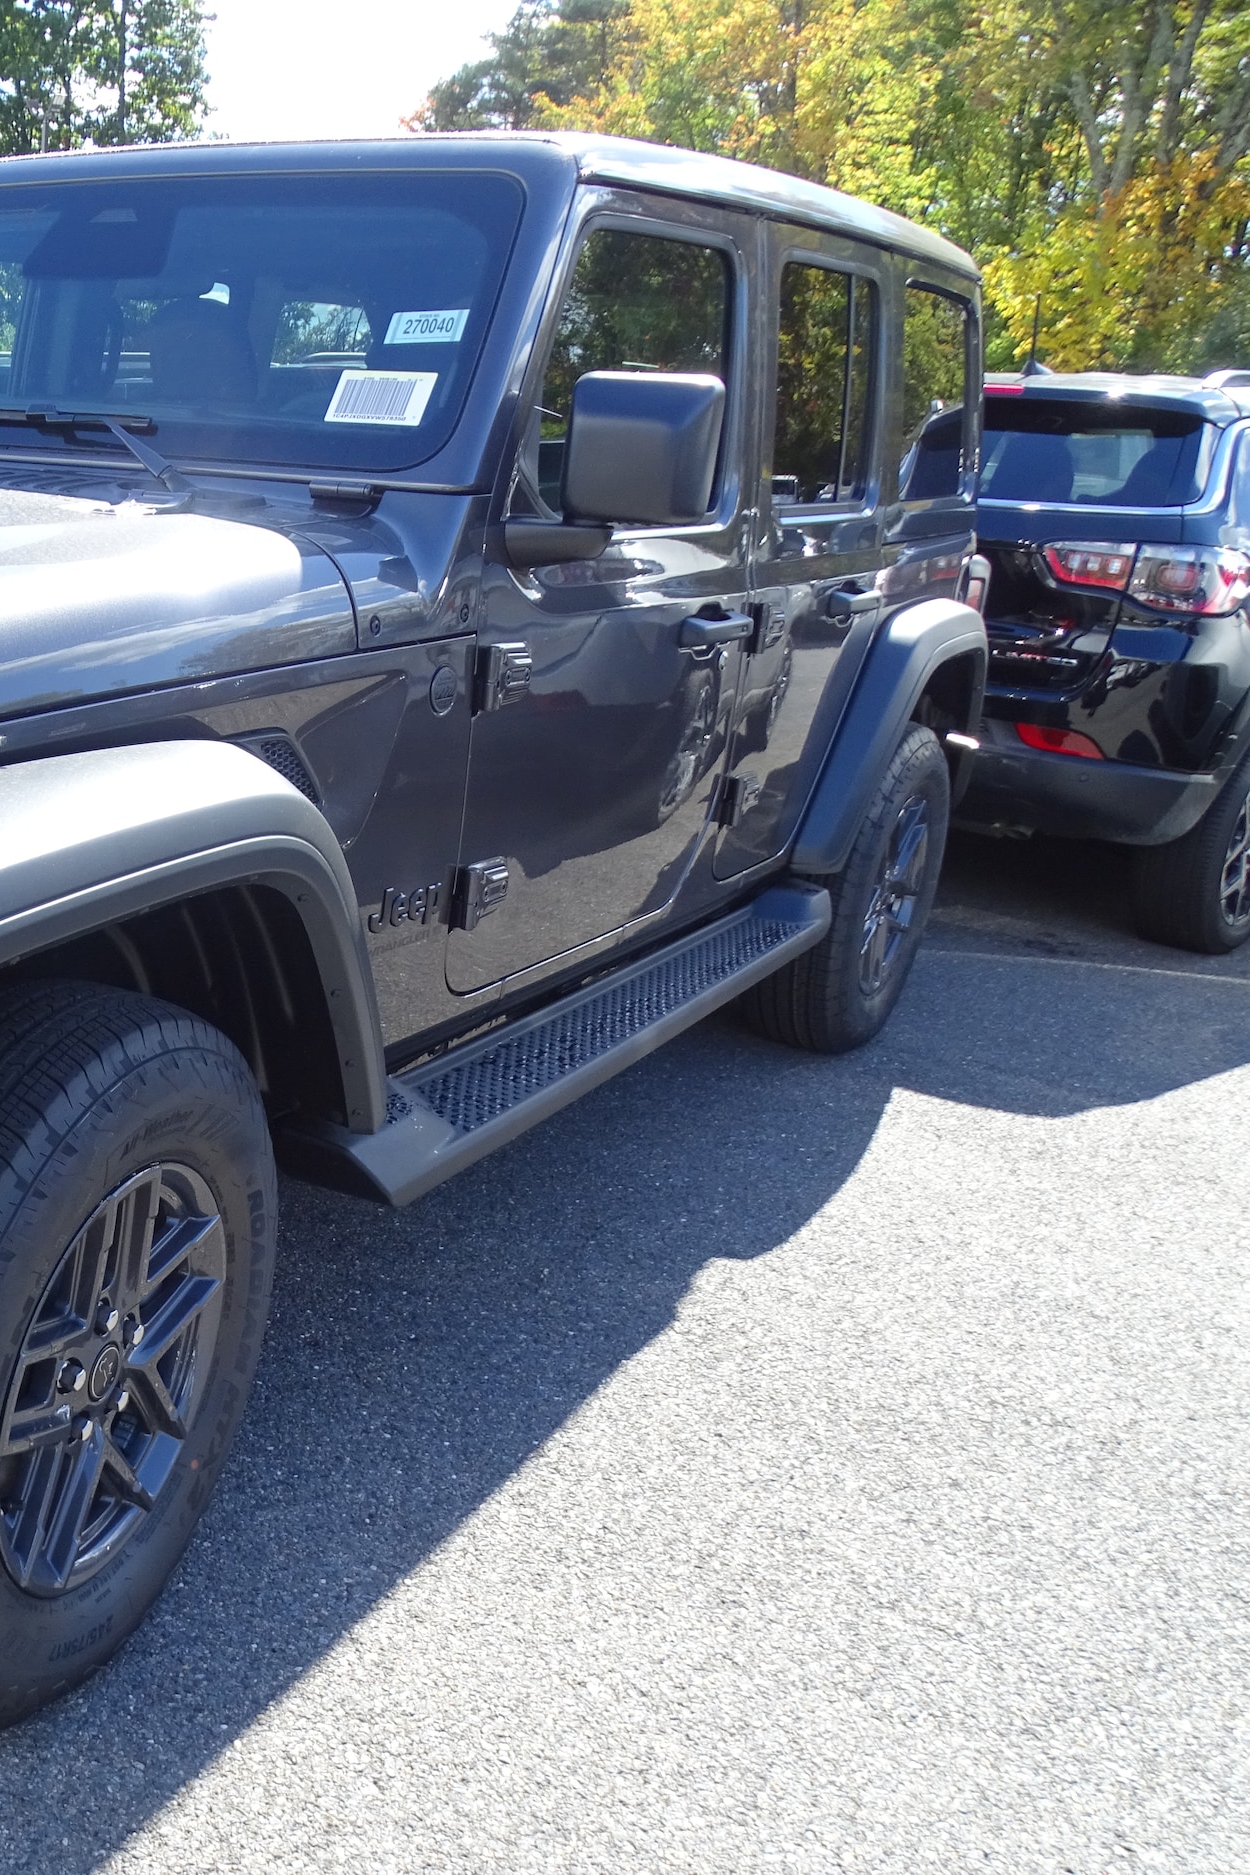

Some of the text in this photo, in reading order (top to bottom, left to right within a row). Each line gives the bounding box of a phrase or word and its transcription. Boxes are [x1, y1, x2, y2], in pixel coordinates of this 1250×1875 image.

[402, 317, 454, 334] 270040
[368, 882, 442, 934] Jeep
[233, 1188, 266, 1376] ROADIAN
[47, 1614, 113, 1662] 245/75R17
